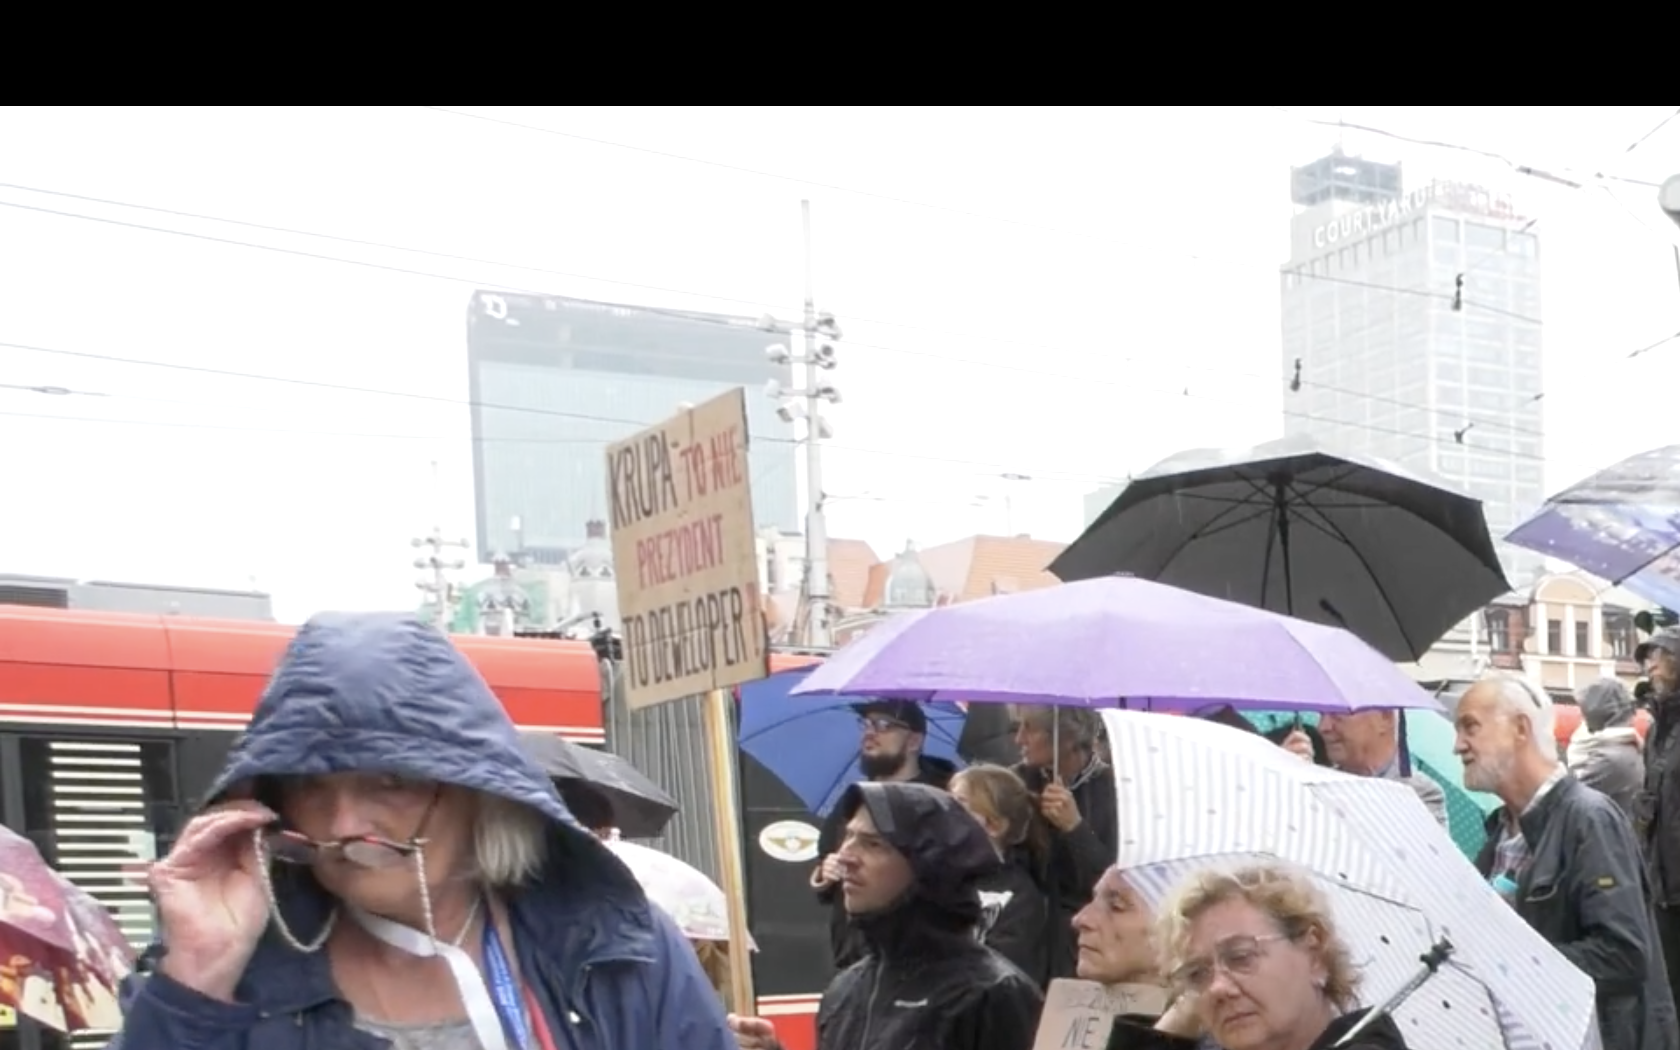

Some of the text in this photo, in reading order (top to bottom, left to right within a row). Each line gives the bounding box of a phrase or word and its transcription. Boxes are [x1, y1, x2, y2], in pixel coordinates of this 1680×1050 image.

[679, 441, 707, 501] TO
[711, 424, 742, 492] NIE
[636, 513, 723, 591] PREZYDENT
